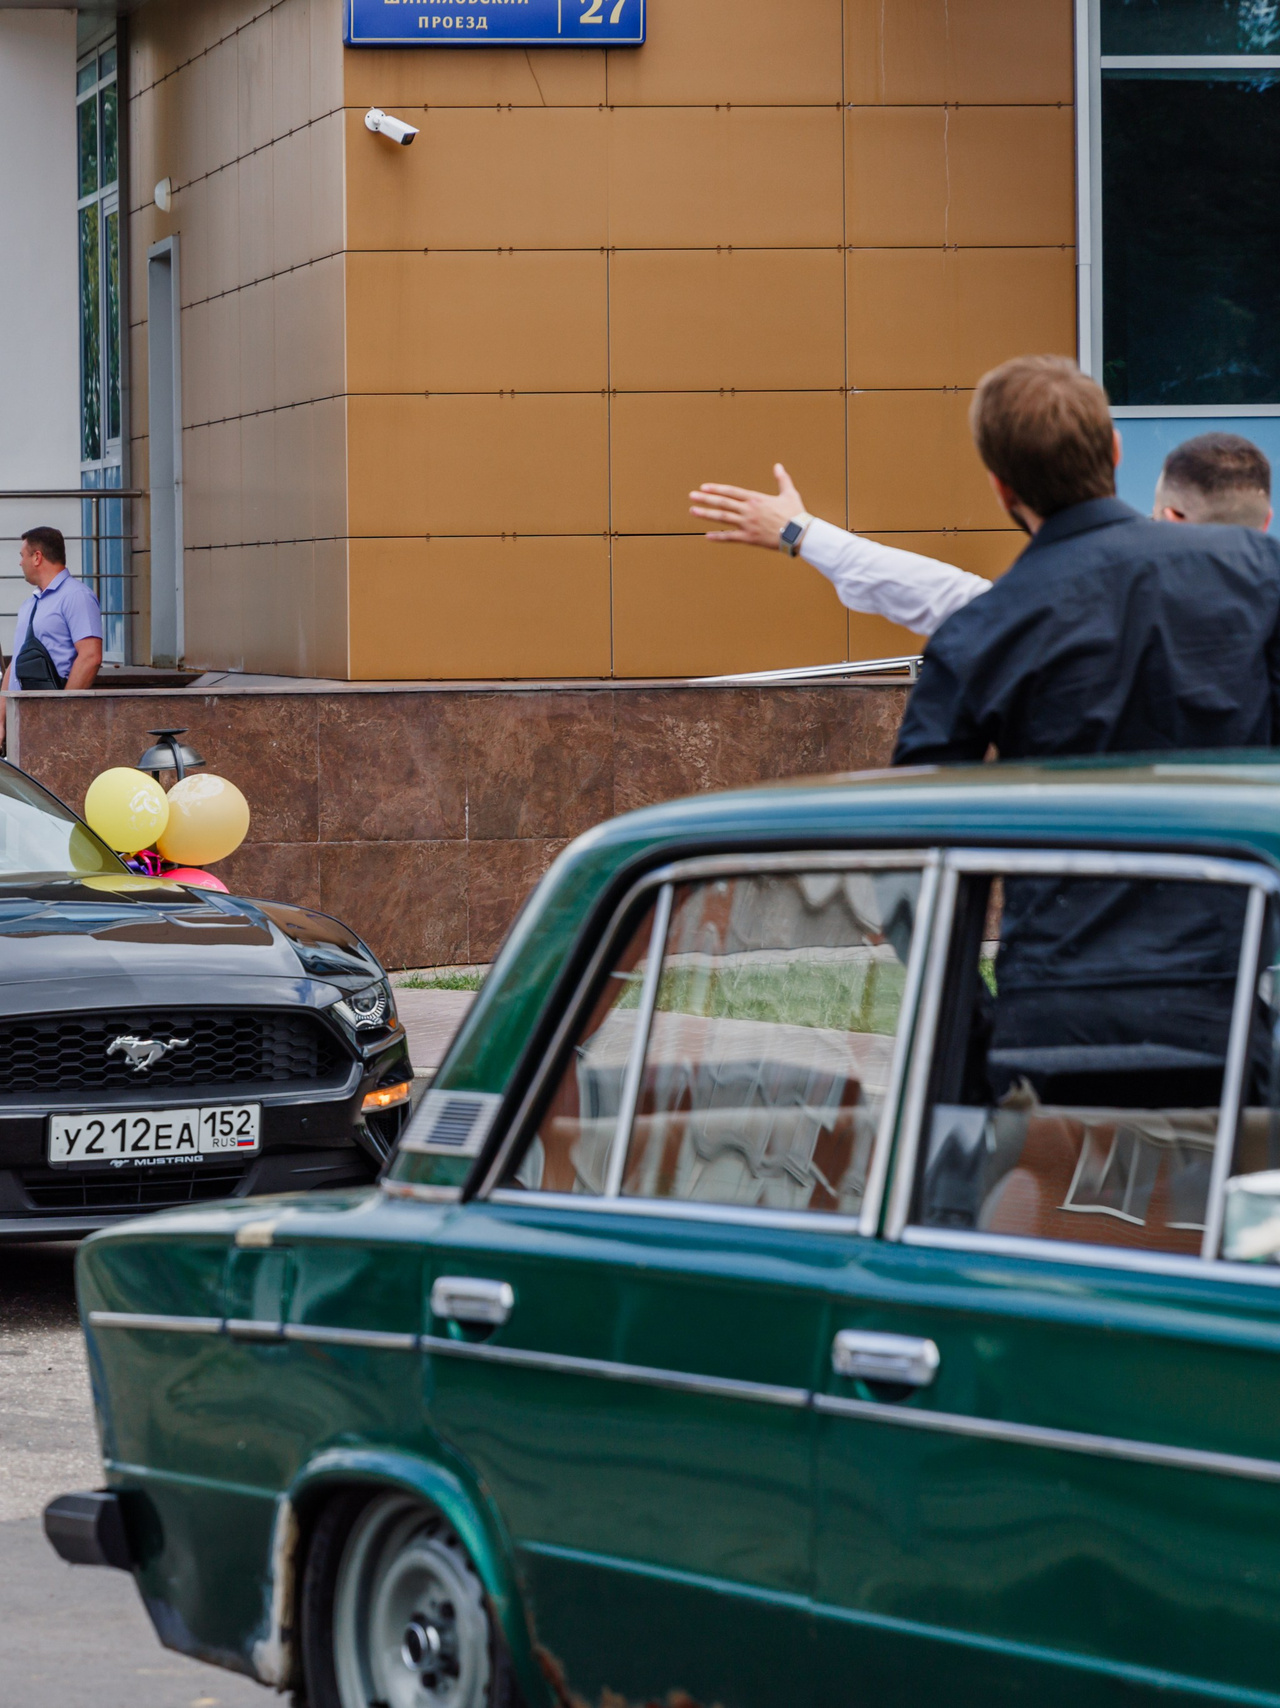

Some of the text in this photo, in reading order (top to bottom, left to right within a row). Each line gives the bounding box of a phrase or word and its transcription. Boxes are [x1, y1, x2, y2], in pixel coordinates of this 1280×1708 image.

[580, 0, 625, 23] 27
[418, 16, 488, 30] ПРОЕЗД
[203, 1109, 252, 1137] 152
[212, 1137, 236, 1148] RUS
[134, 1154, 204, 1167] MUSTANG
